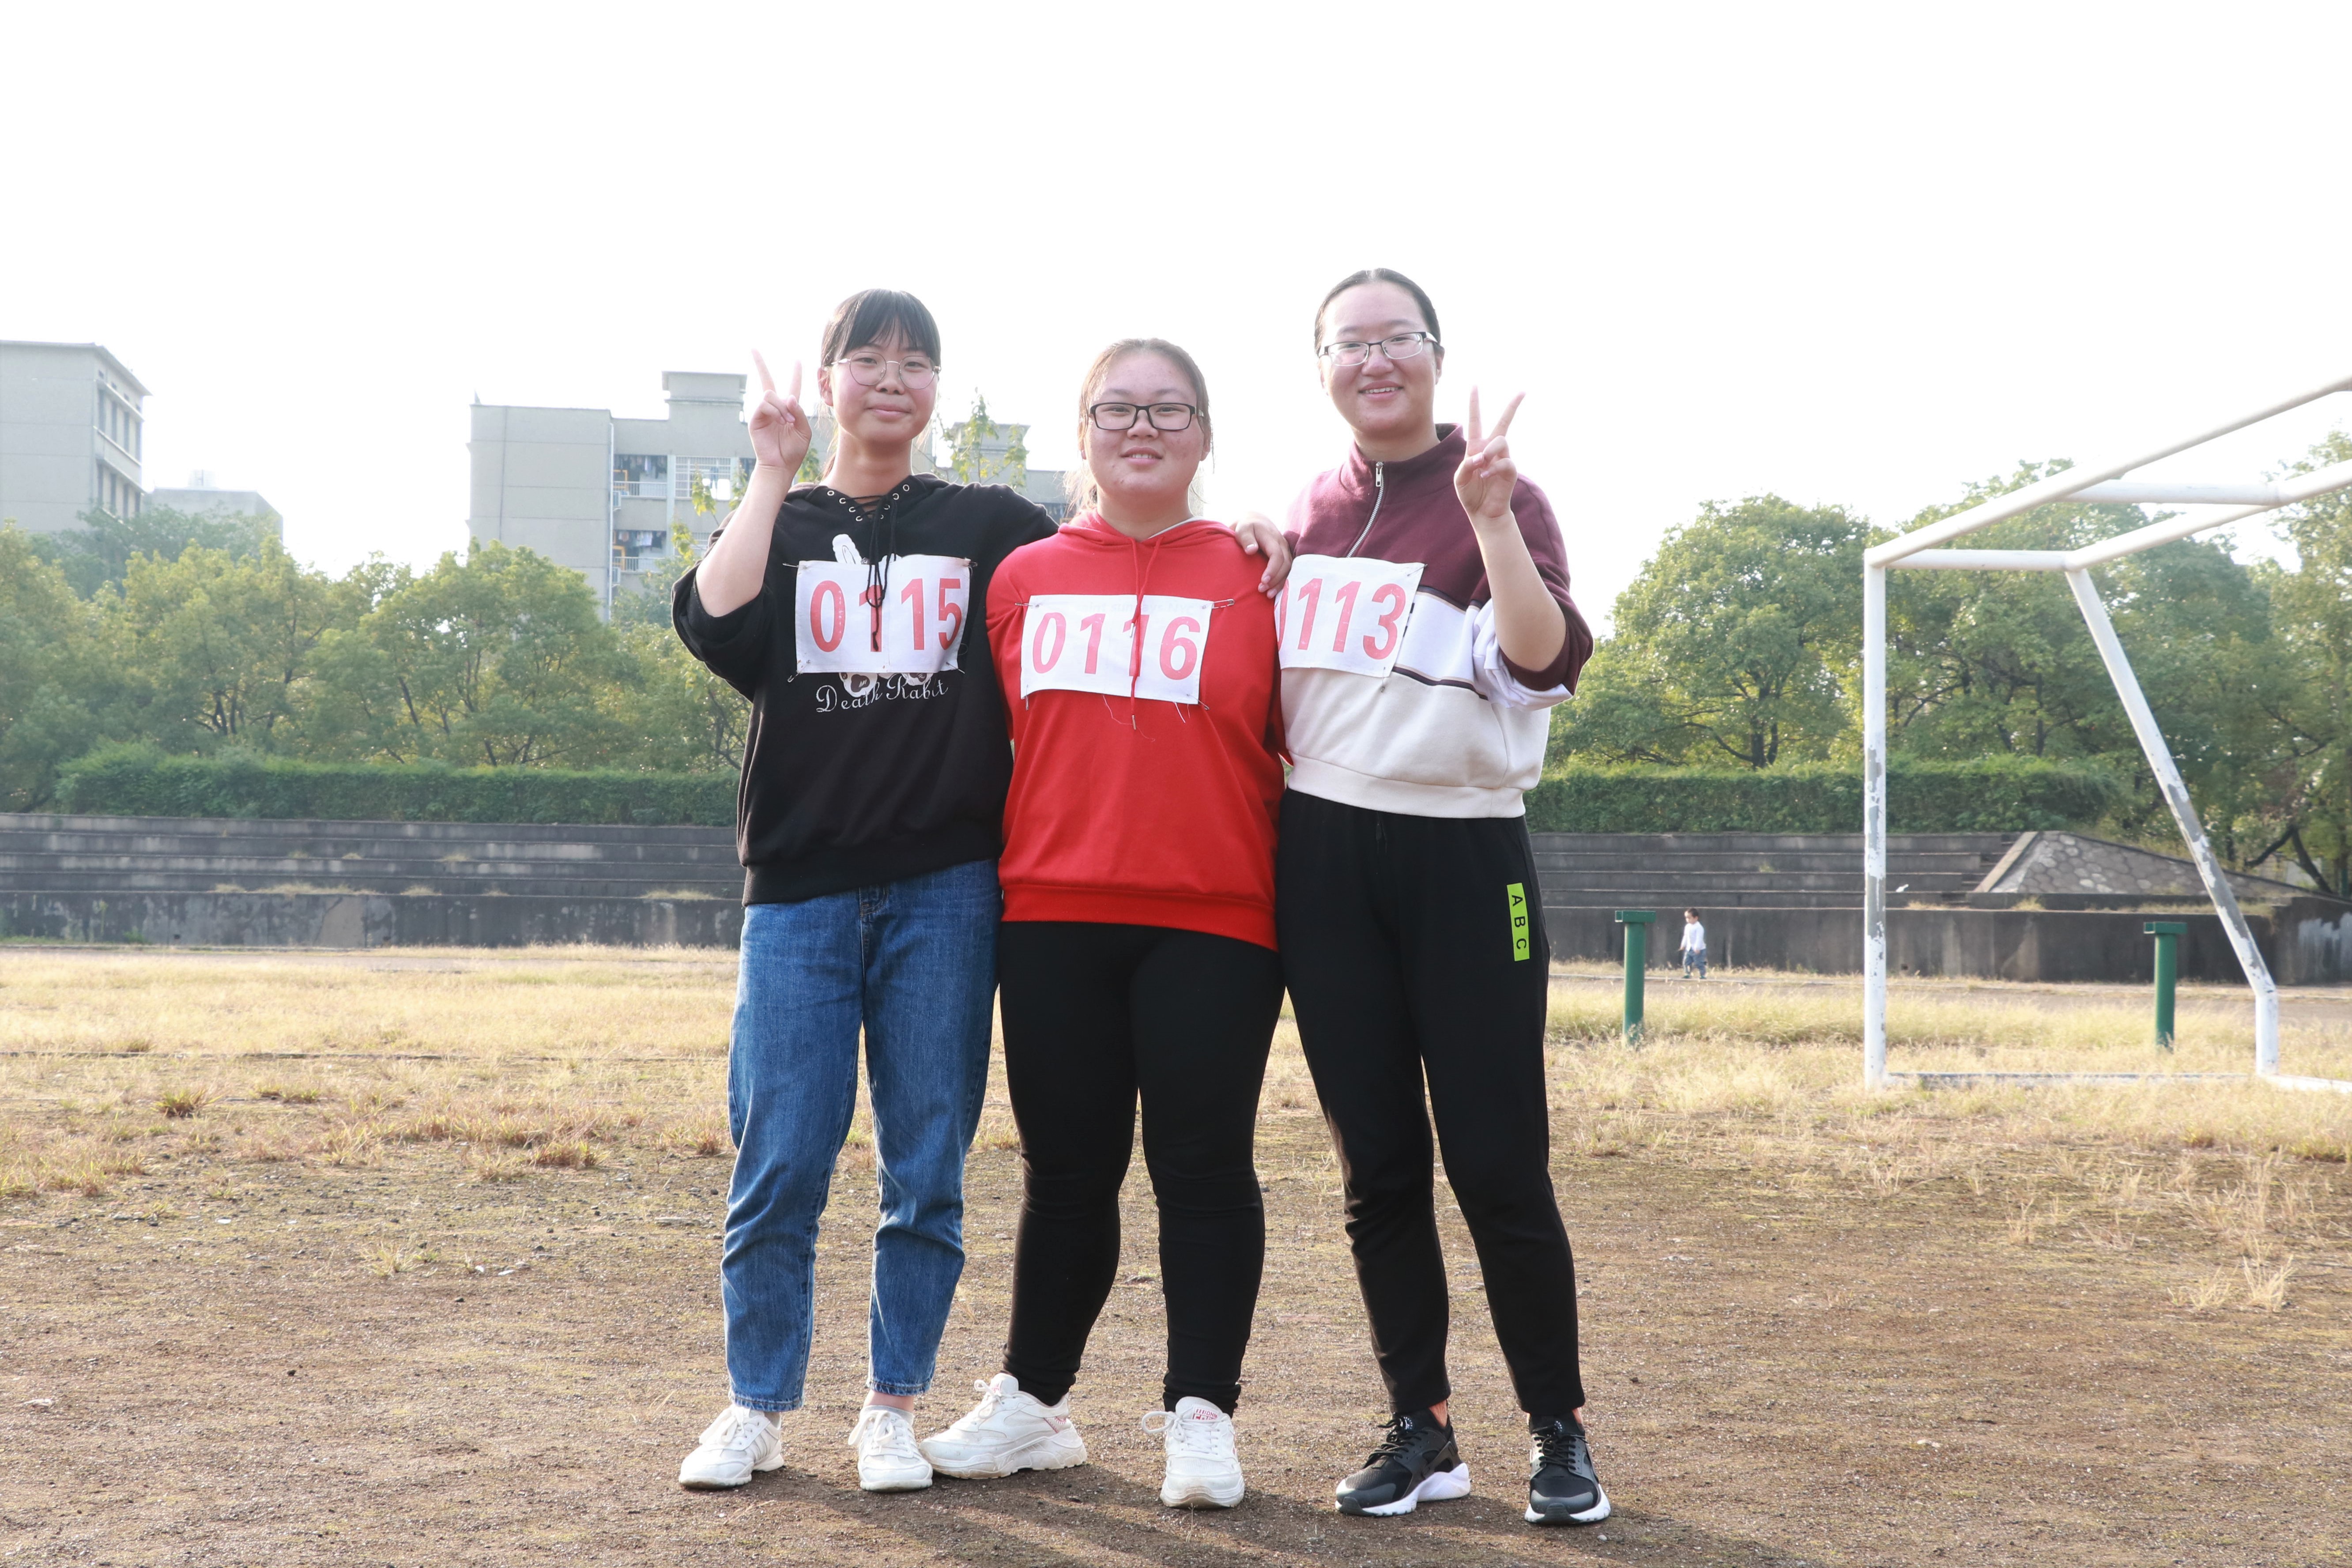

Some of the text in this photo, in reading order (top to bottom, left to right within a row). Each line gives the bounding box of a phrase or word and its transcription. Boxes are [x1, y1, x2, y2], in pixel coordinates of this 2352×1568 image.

[810, 578, 962, 652] 0115
[1033, 612, 1200, 680] 0116
[816, 682, 882, 712] Death
[1511, 895, 1527, 950] ABC
